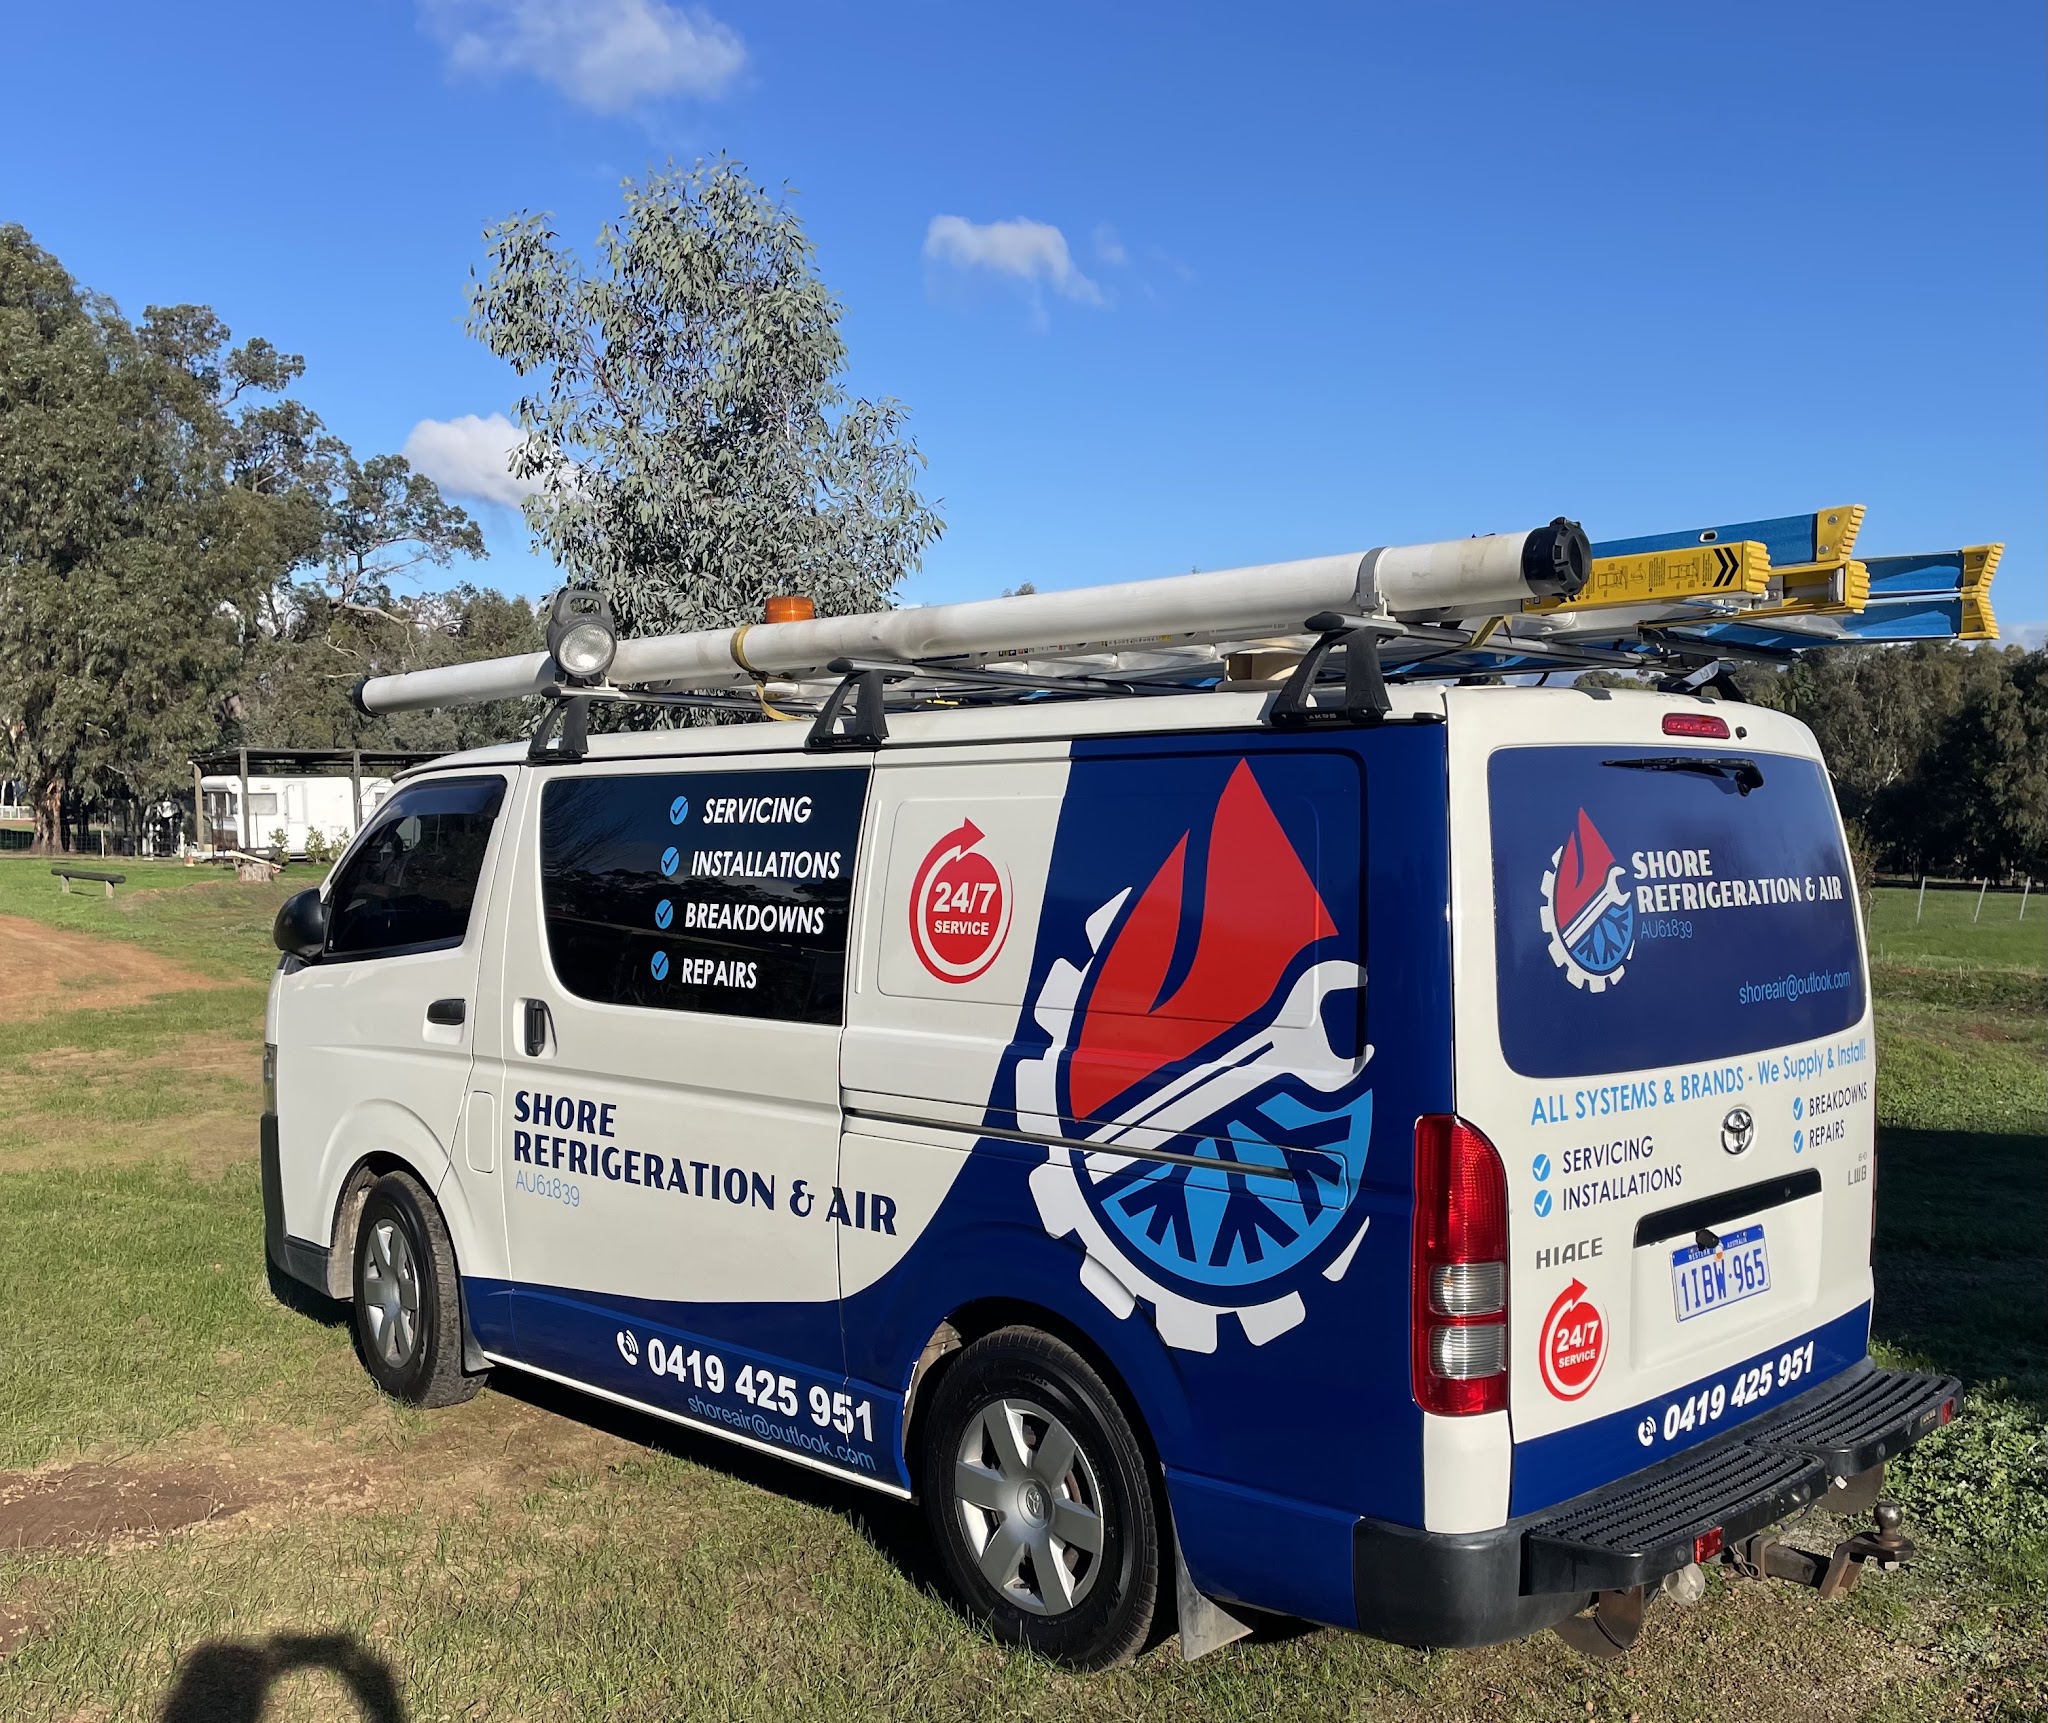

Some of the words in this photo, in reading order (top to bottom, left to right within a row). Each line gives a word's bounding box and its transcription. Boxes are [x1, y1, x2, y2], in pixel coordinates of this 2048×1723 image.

[702, 796, 812, 824] SERVICING
[691, 850, 841, 880] INSTALLATIONS
[1631, 849, 1713, 880] SHORE
[932, 881, 997, 914] 24/7
[1636, 877, 1802, 914] REFRIGERATION
[1805, 875, 1816, 902] &
[1819, 875, 1843, 901] AIR
[685, 902, 826, 935] BREAKDOWNS
[934, 920, 990, 936] SERVICE
[1640, 918, 1693, 939] AU61839
[682, 957, 757, 989] REPAIRS
[1739, 969, 1851, 1005] shoreair@outlook.com
[1531, 1094, 1569, 1126] ALL
[1575, 1080, 1657, 1119] SYSTEMS
[1664, 1079, 1675, 1104] &
[1681, 1066, 1744, 1102] BRANDS
[1757, 1060, 1779, 1086] We
[1783, 1048, 1824, 1082] Supply
[1827, 1047, 1835, 1070] &
[1837, 1038, 1867, 1067] Install!
[1809, 1081, 1867, 1117] BREAKDOWNS
[514, 1090, 617, 1138] SHORE
[1809, 1118, 1845, 1149] REPAIRS
[1562, 1135, 1654, 1174] SERVICING
[514, 1129, 776, 1211] REFRIGERATION
[789, 1179, 815, 1218] &
[825, 1186, 897, 1236] AIR
[515, 1168, 580, 1208] AU61839
[1562, 1163, 1682, 1212] INSTALLATIONS
[1847, 1164, 1867, 1186] LWB
[1536, 1237, 1603, 1270] HIACE
[1556, 1319, 1599, 1353] 24/7
[1558, 1348, 1596, 1369] SERVICE
[647, 1337, 725, 1394] 0419
[735, 1364, 798, 1417] 425
[809, 1385, 873, 1442] 951
[1663, 1384, 1726, 1441] 0419
[1730, 1361, 1774, 1408] 425
[1777, 1340, 1814, 1388] 951
[687, 1394, 877, 1472] shoreair@outlook.com
